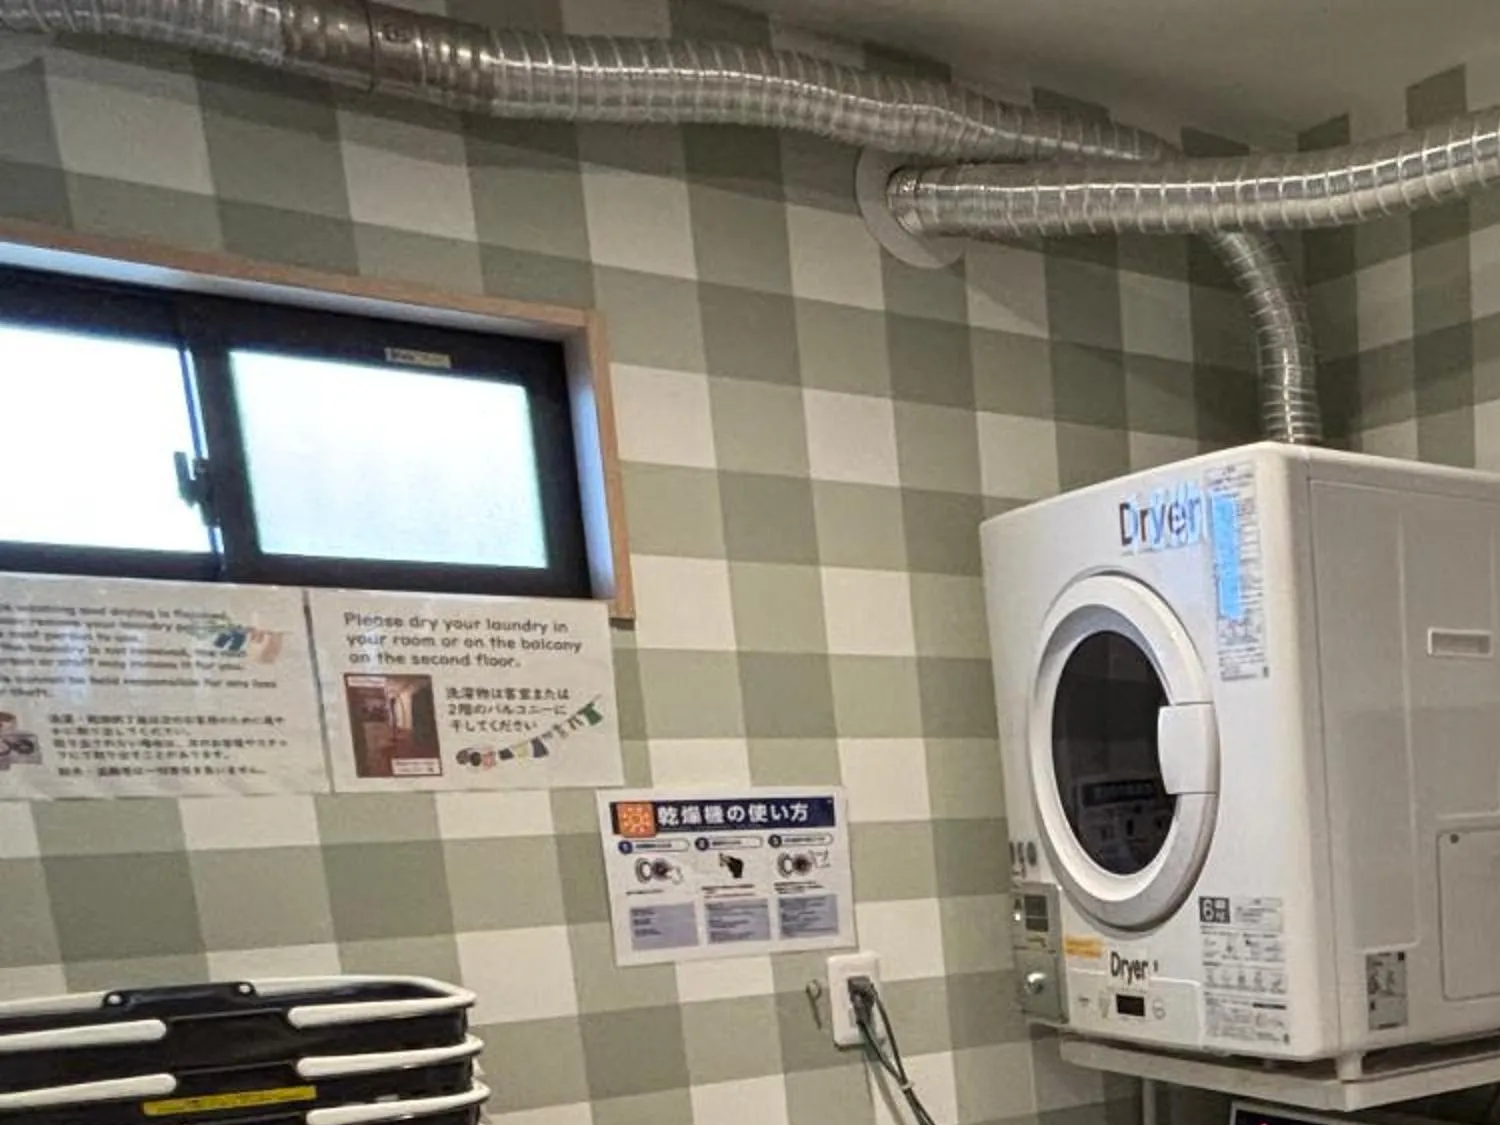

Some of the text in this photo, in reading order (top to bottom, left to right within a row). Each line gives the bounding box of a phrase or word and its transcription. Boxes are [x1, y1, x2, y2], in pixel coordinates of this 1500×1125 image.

[1119, 497, 1200, 546] Dryer
[344, 611, 568, 636] Please dry your laundry in
[347, 635, 582, 654] your room or on the balcony
[348, 652, 521, 669] on the second floor.
[657, 802, 810, 827] 乾燥機の使い方
[1111, 951, 1149, 986] Dryer
